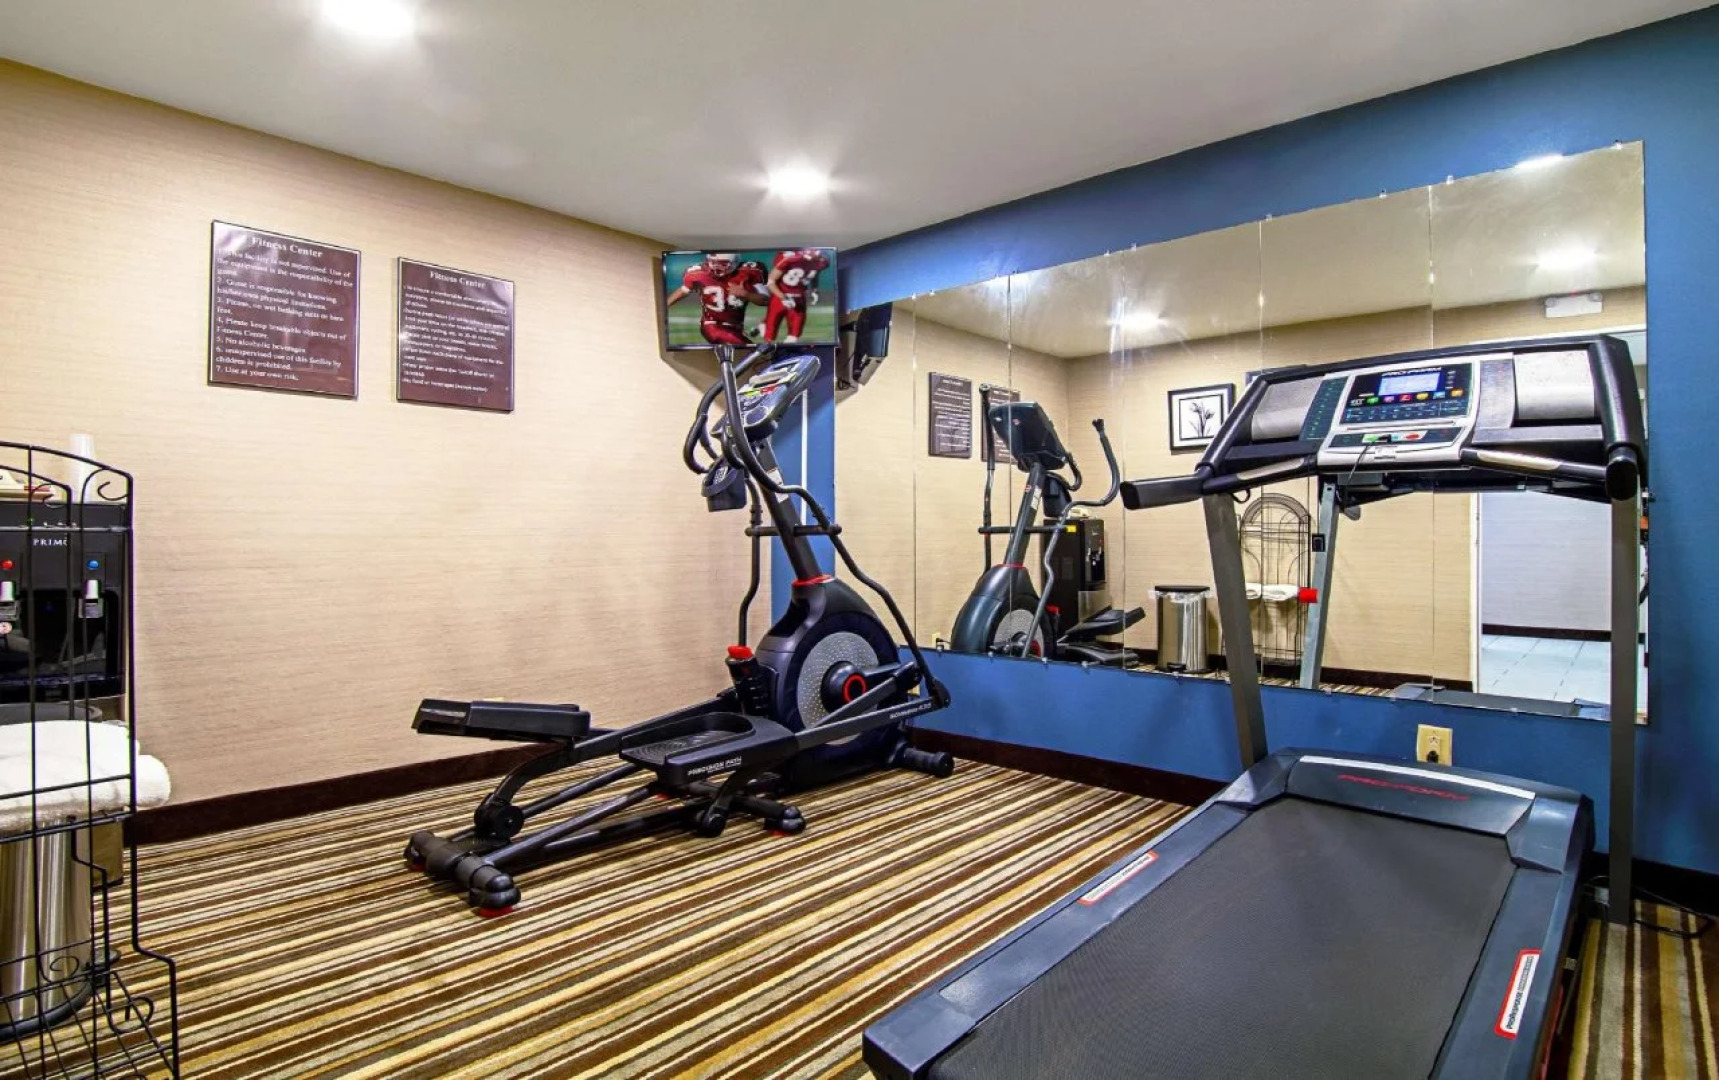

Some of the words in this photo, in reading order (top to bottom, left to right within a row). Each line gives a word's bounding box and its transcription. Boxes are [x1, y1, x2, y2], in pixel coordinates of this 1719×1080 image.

[252, 237, 286, 251] Fitness
[289, 244, 323, 258] Center
[277, 268, 286, 276] the
[335, 278, 341, 286] of
[329, 268, 341, 276] Use
[429, 270, 457, 283] Fitness
[458, 275, 485, 288] Center
[256, 283, 294, 296] responsible
[297, 290, 306, 298] for
[308, 292, 337, 303] knowing
[259, 294, 289, 305] physical
[264, 303, 275, 312] wet
[277, 305, 302, 316] bathing
[225, 317, 248, 327] Please
[250, 321, 267, 329] keep
[216, 335, 223, 343] 5.
[238, 338, 270, 349] alcoholic
[215, 355, 245, 365] children
[285, 353, 293, 361] of
[295, 355, 307, 363] this
[332, 359, 341, 367] by
[224, 366, 238, 374] Use
[240, 367, 247, 375] at
[249, 368, 266, 377] your
[266, 370, 282, 379] own
[283, 372, 299, 380] risk.
[688, 762, 725, 775] PRECISION
